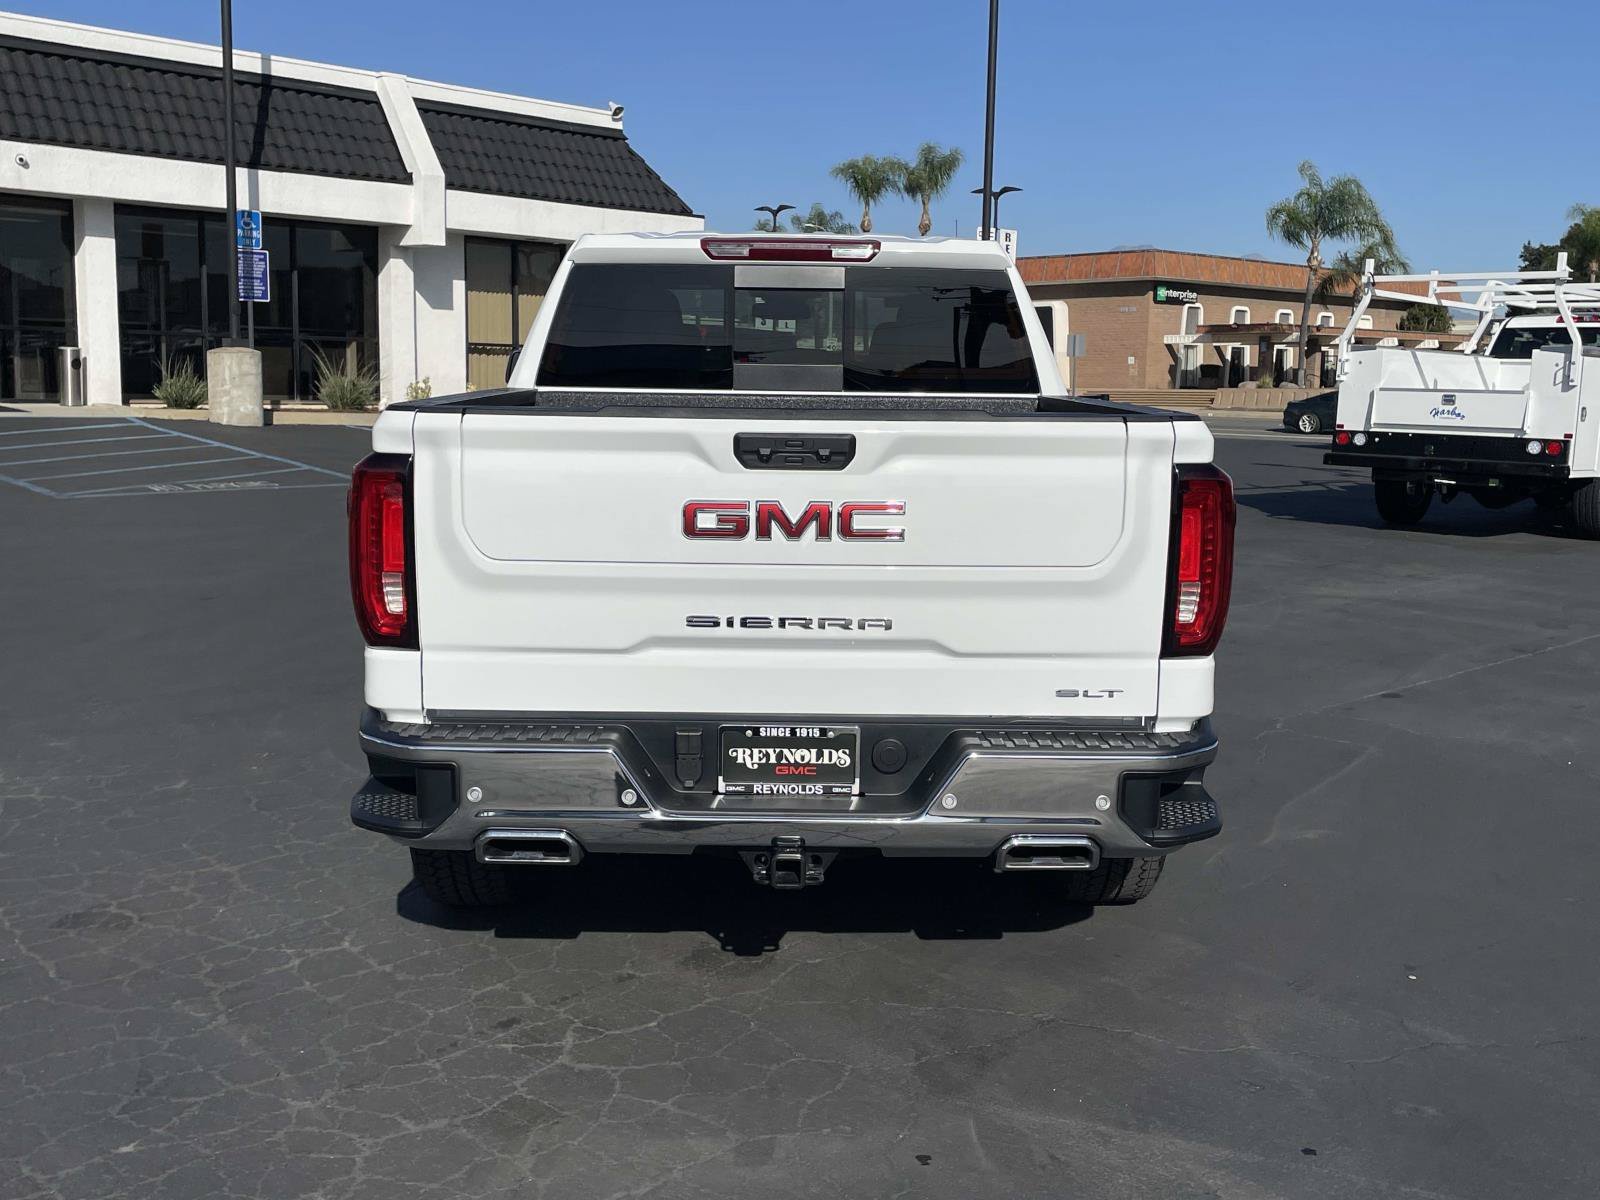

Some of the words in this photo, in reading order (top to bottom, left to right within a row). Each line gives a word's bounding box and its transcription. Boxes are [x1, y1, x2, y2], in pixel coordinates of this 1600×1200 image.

[237, 229, 260, 238] PARKING
[1159, 289, 1198, 300] enterprise
[681, 500, 906, 542] GMC
[685, 615, 893, 631] SIERRA
[1055, 689, 1125, 698] SLT
[760, 727, 791, 737] SINCE
[795, 728, 820, 737] 1915
[728, 748, 851, 769] REYNOLDS
[775, 766, 817, 775] GMC
[753, 785, 824, 794] REYNOLDS
